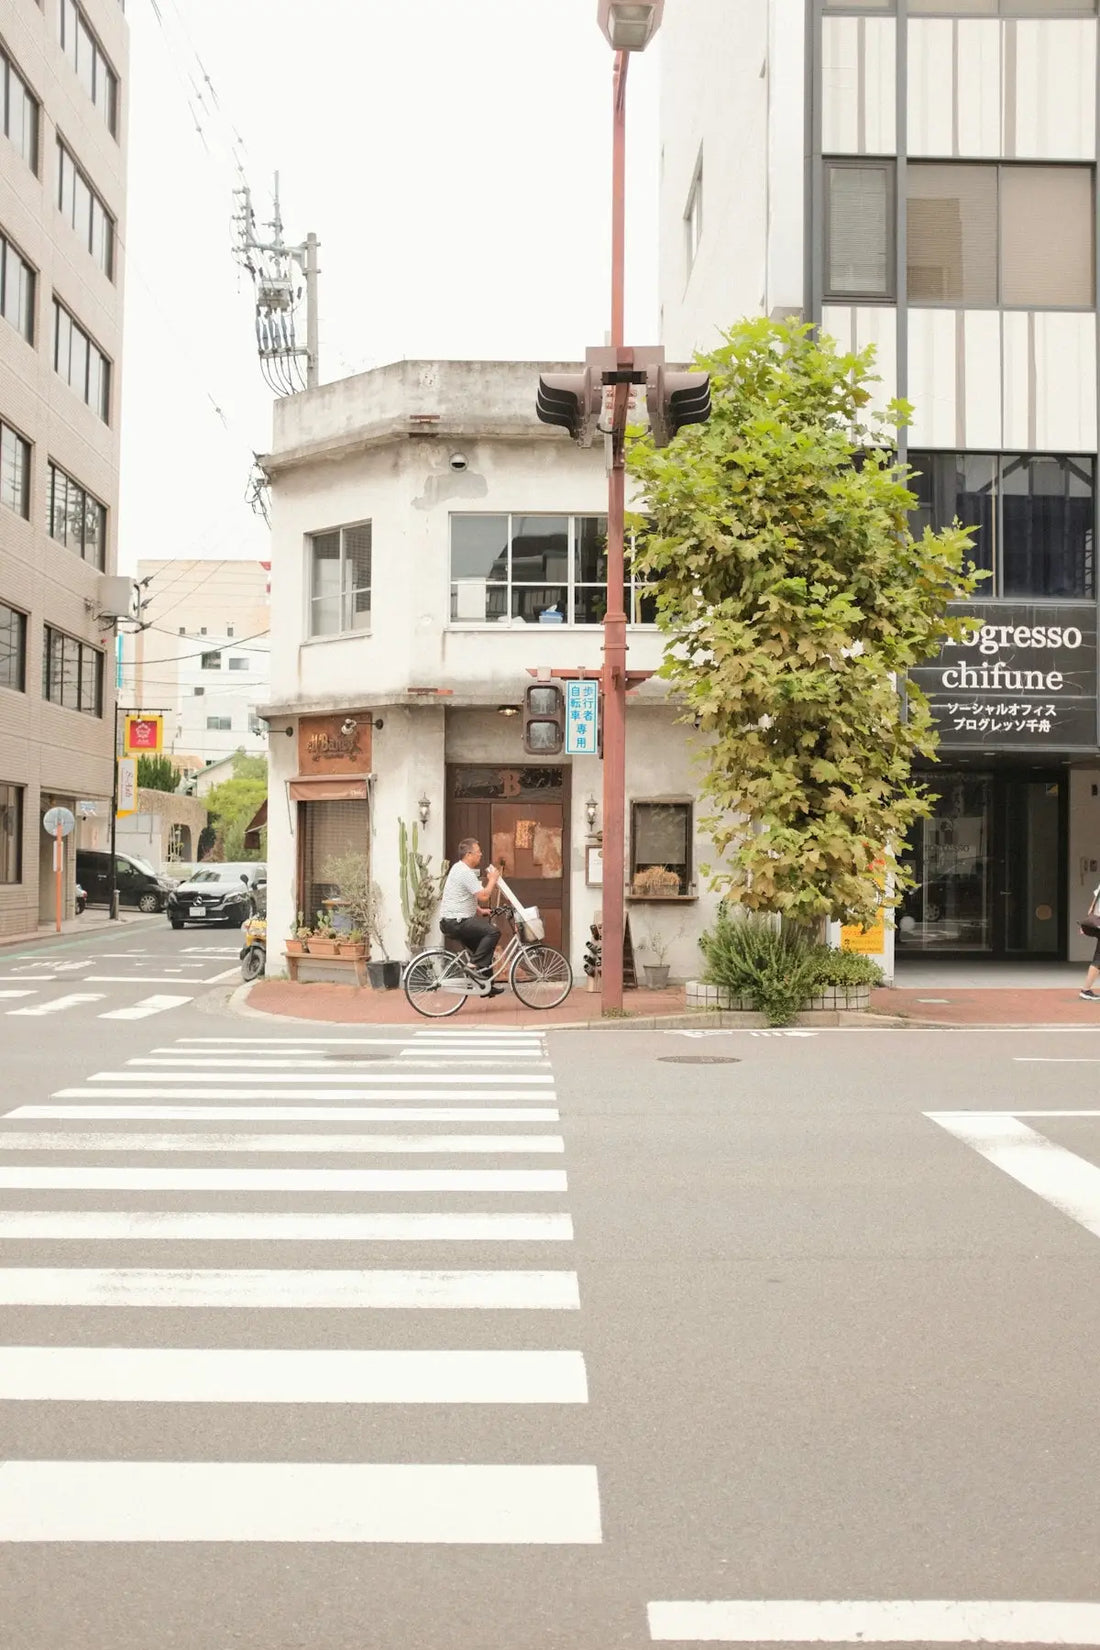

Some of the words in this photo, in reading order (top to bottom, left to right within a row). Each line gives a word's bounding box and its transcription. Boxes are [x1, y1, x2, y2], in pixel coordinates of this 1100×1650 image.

[942, 661, 1064, 690] chifune
[570, 686, 581, 720] 自転車
[583, 686, 593, 721] 歩行者
[947, 702, 1057, 716] ソーシャルオフィス
[576, 723, 587, 748] 専用
[953, 717, 1052, 733] プログレッソ千舟
